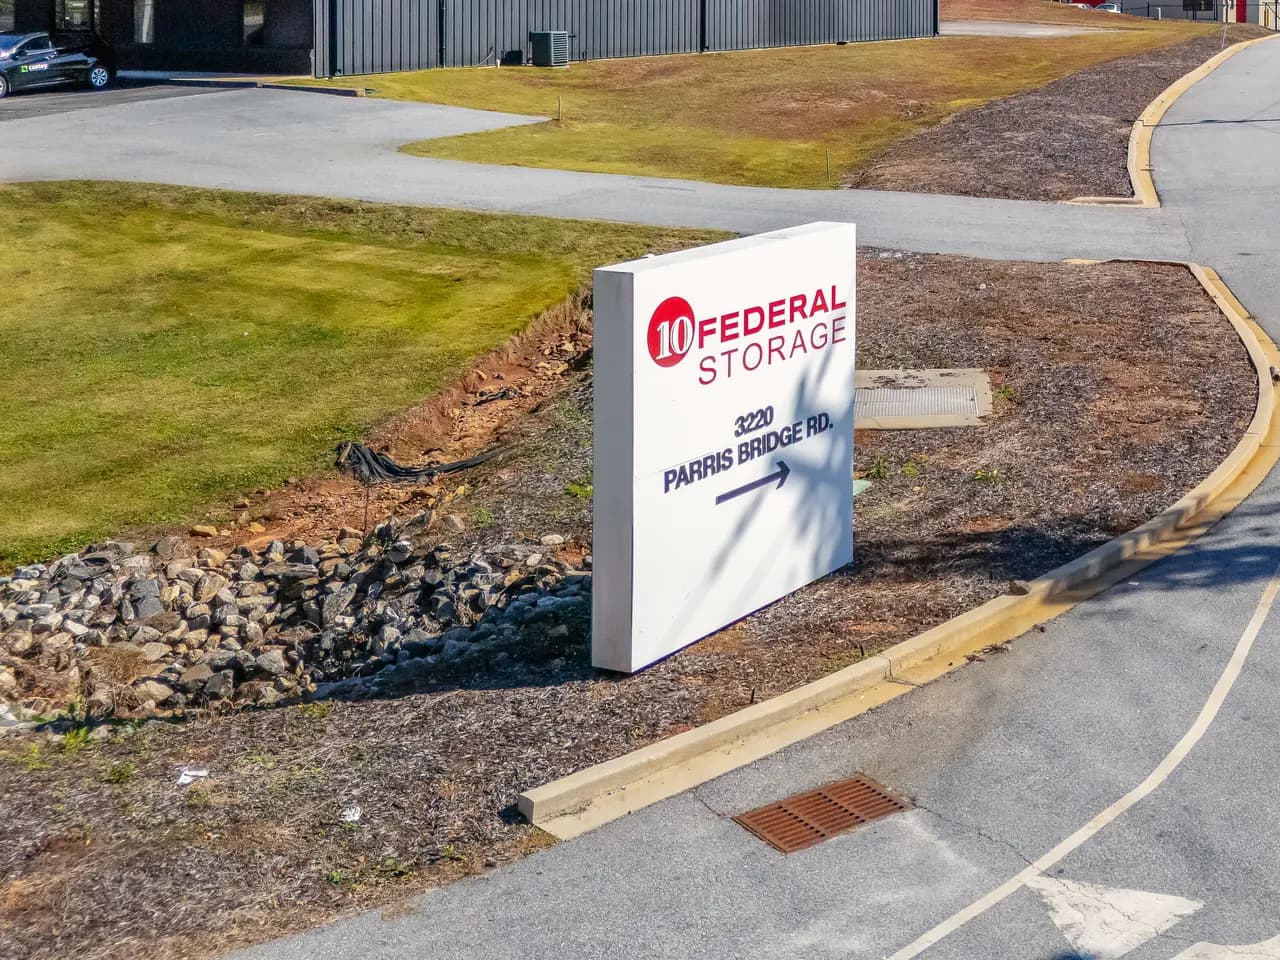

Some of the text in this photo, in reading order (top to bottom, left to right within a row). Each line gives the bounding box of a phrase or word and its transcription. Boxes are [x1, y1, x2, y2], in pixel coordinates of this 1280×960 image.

[656, 285, 847, 360] 10 FEDERAL
[698, 316, 846, 385] STORAGE
[663, 412, 834, 493] PARRIS BRIDGE RD.
[734, 405, 774, 437] 3220
